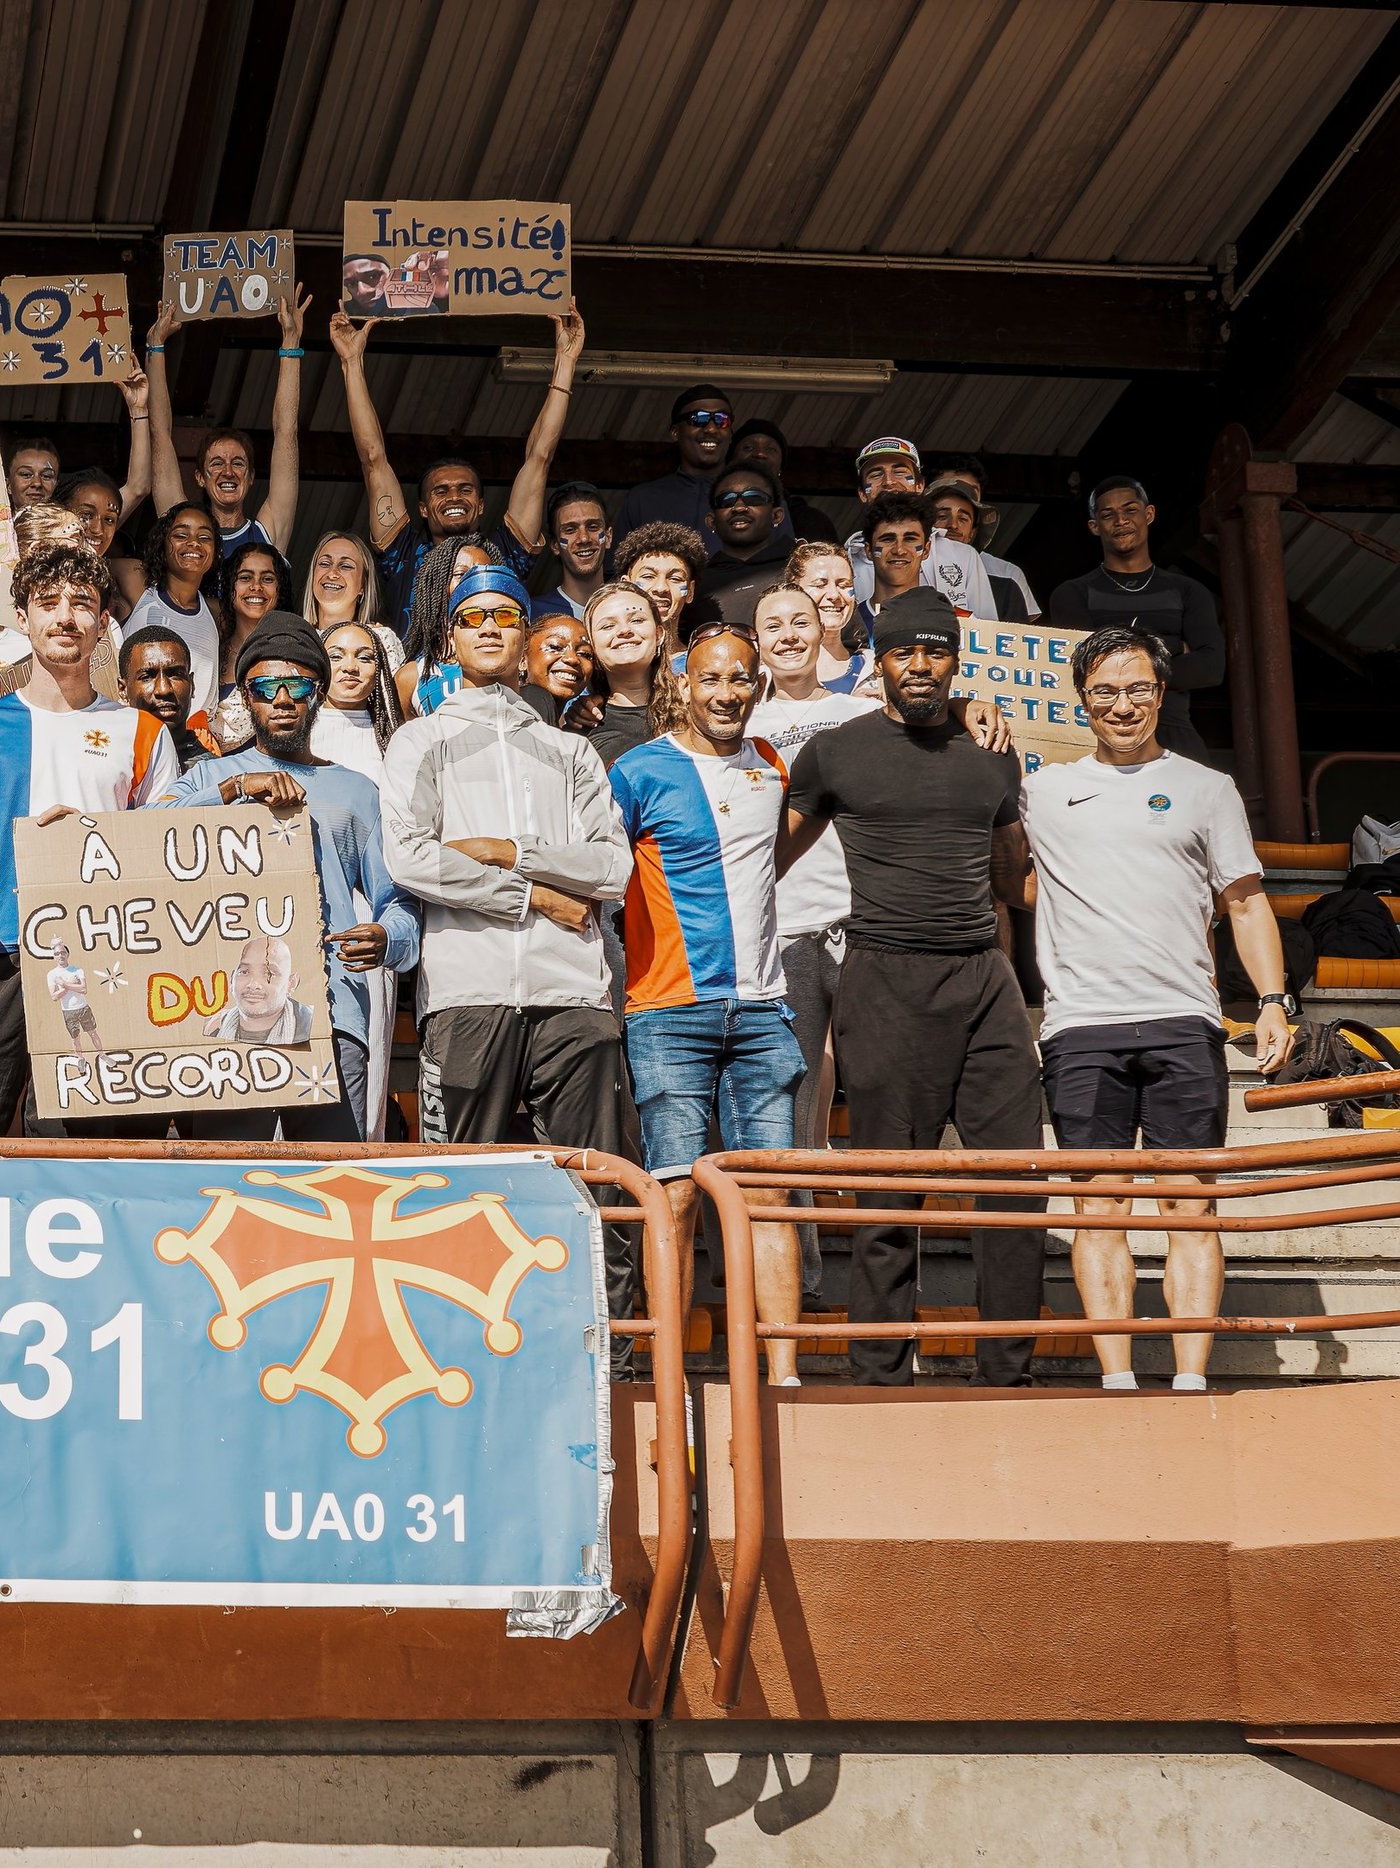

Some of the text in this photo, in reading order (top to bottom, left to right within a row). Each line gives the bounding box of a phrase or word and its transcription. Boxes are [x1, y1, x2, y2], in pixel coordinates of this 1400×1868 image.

[173, 235, 279, 272] TEAM
[178, 274, 269, 315] UAO
[32, 336, 104, 380] 31
[915, 633, 948, 642] KIPRUN
[960, 626, 1085, 664] LETE
[80, 816, 265, 885] À UN
[23, 894, 295, 960] CHEVEU
[146, 968, 230, 1028] DU
[55, 1047, 294, 1110] RECORD
[405, 1494, 467, 1543] 31
